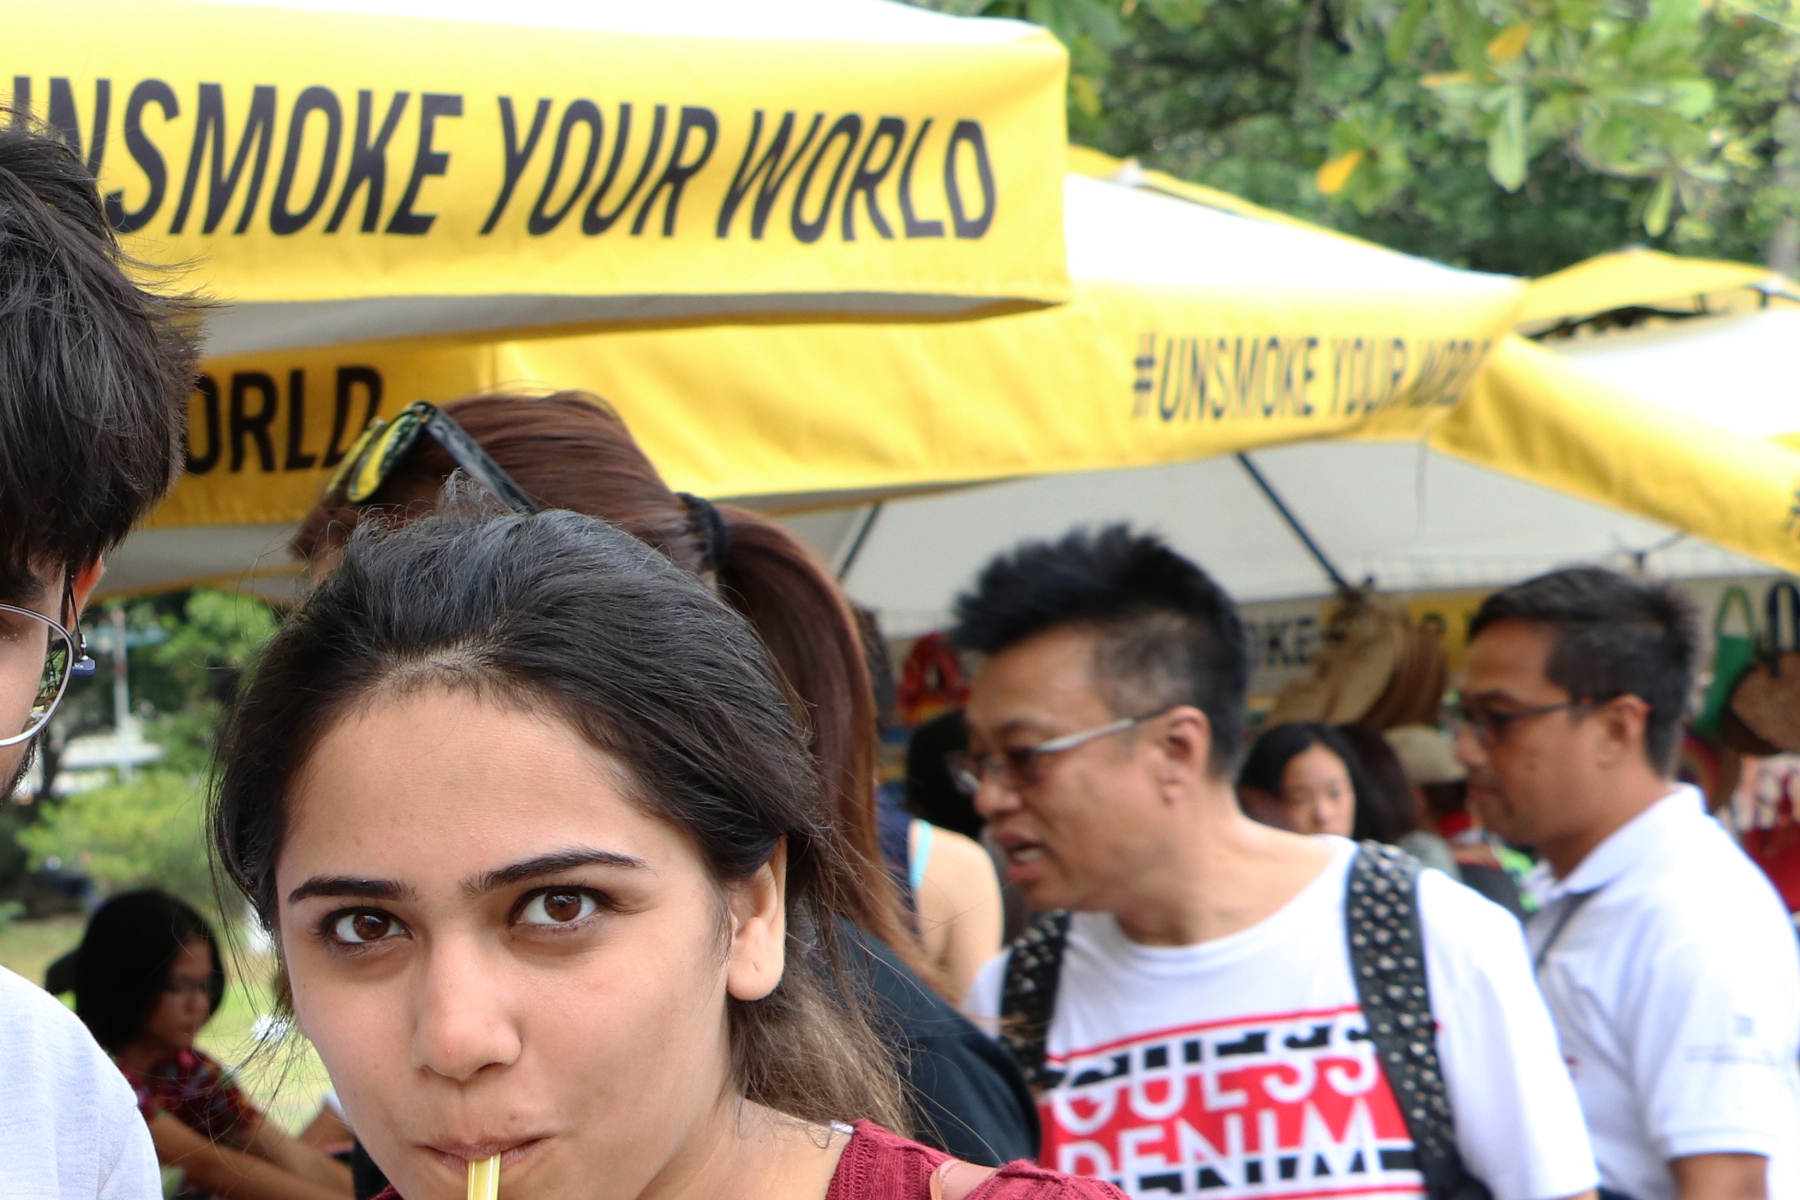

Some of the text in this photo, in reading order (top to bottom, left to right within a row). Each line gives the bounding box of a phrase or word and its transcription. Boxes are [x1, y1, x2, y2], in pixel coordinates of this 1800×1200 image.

[480, 96, 717, 237] YOUR
[716, 109, 996, 244] WORLD
[184, 366, 383, 475] ORLD
[1133, 333, 1319, 421] #UNSMOKE
[1052, 1020, 1379, 1137] GUESS
[1057, 1097, 1392, 1198] DENIM
